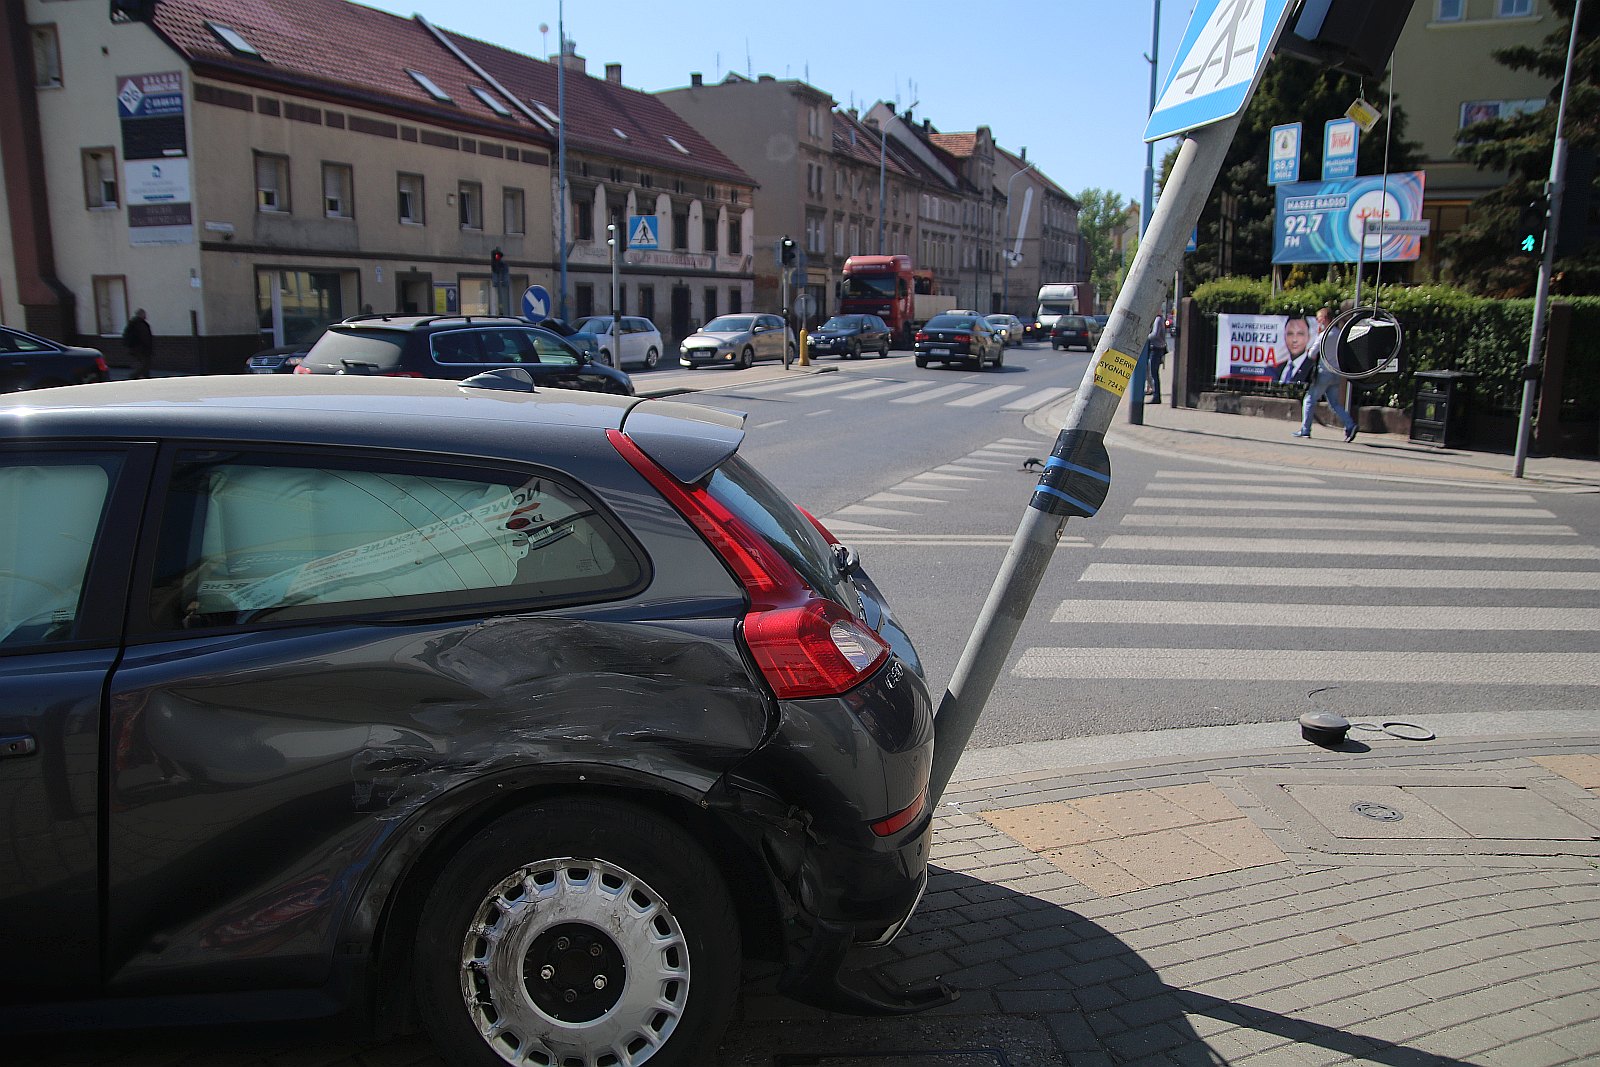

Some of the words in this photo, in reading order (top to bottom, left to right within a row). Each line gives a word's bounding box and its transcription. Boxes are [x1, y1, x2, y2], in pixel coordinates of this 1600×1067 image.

[1287, 200, 1315, 210] NASZE
[1315, 198, 1347, 208] RADIO
[1284, 214, 1323, 234] 92,7
[1284, 236, 1300, 247] FM
[1231, 332, 1278, 343] ANDRZEJ
[1231, 344, 1276, 364] DUDA
